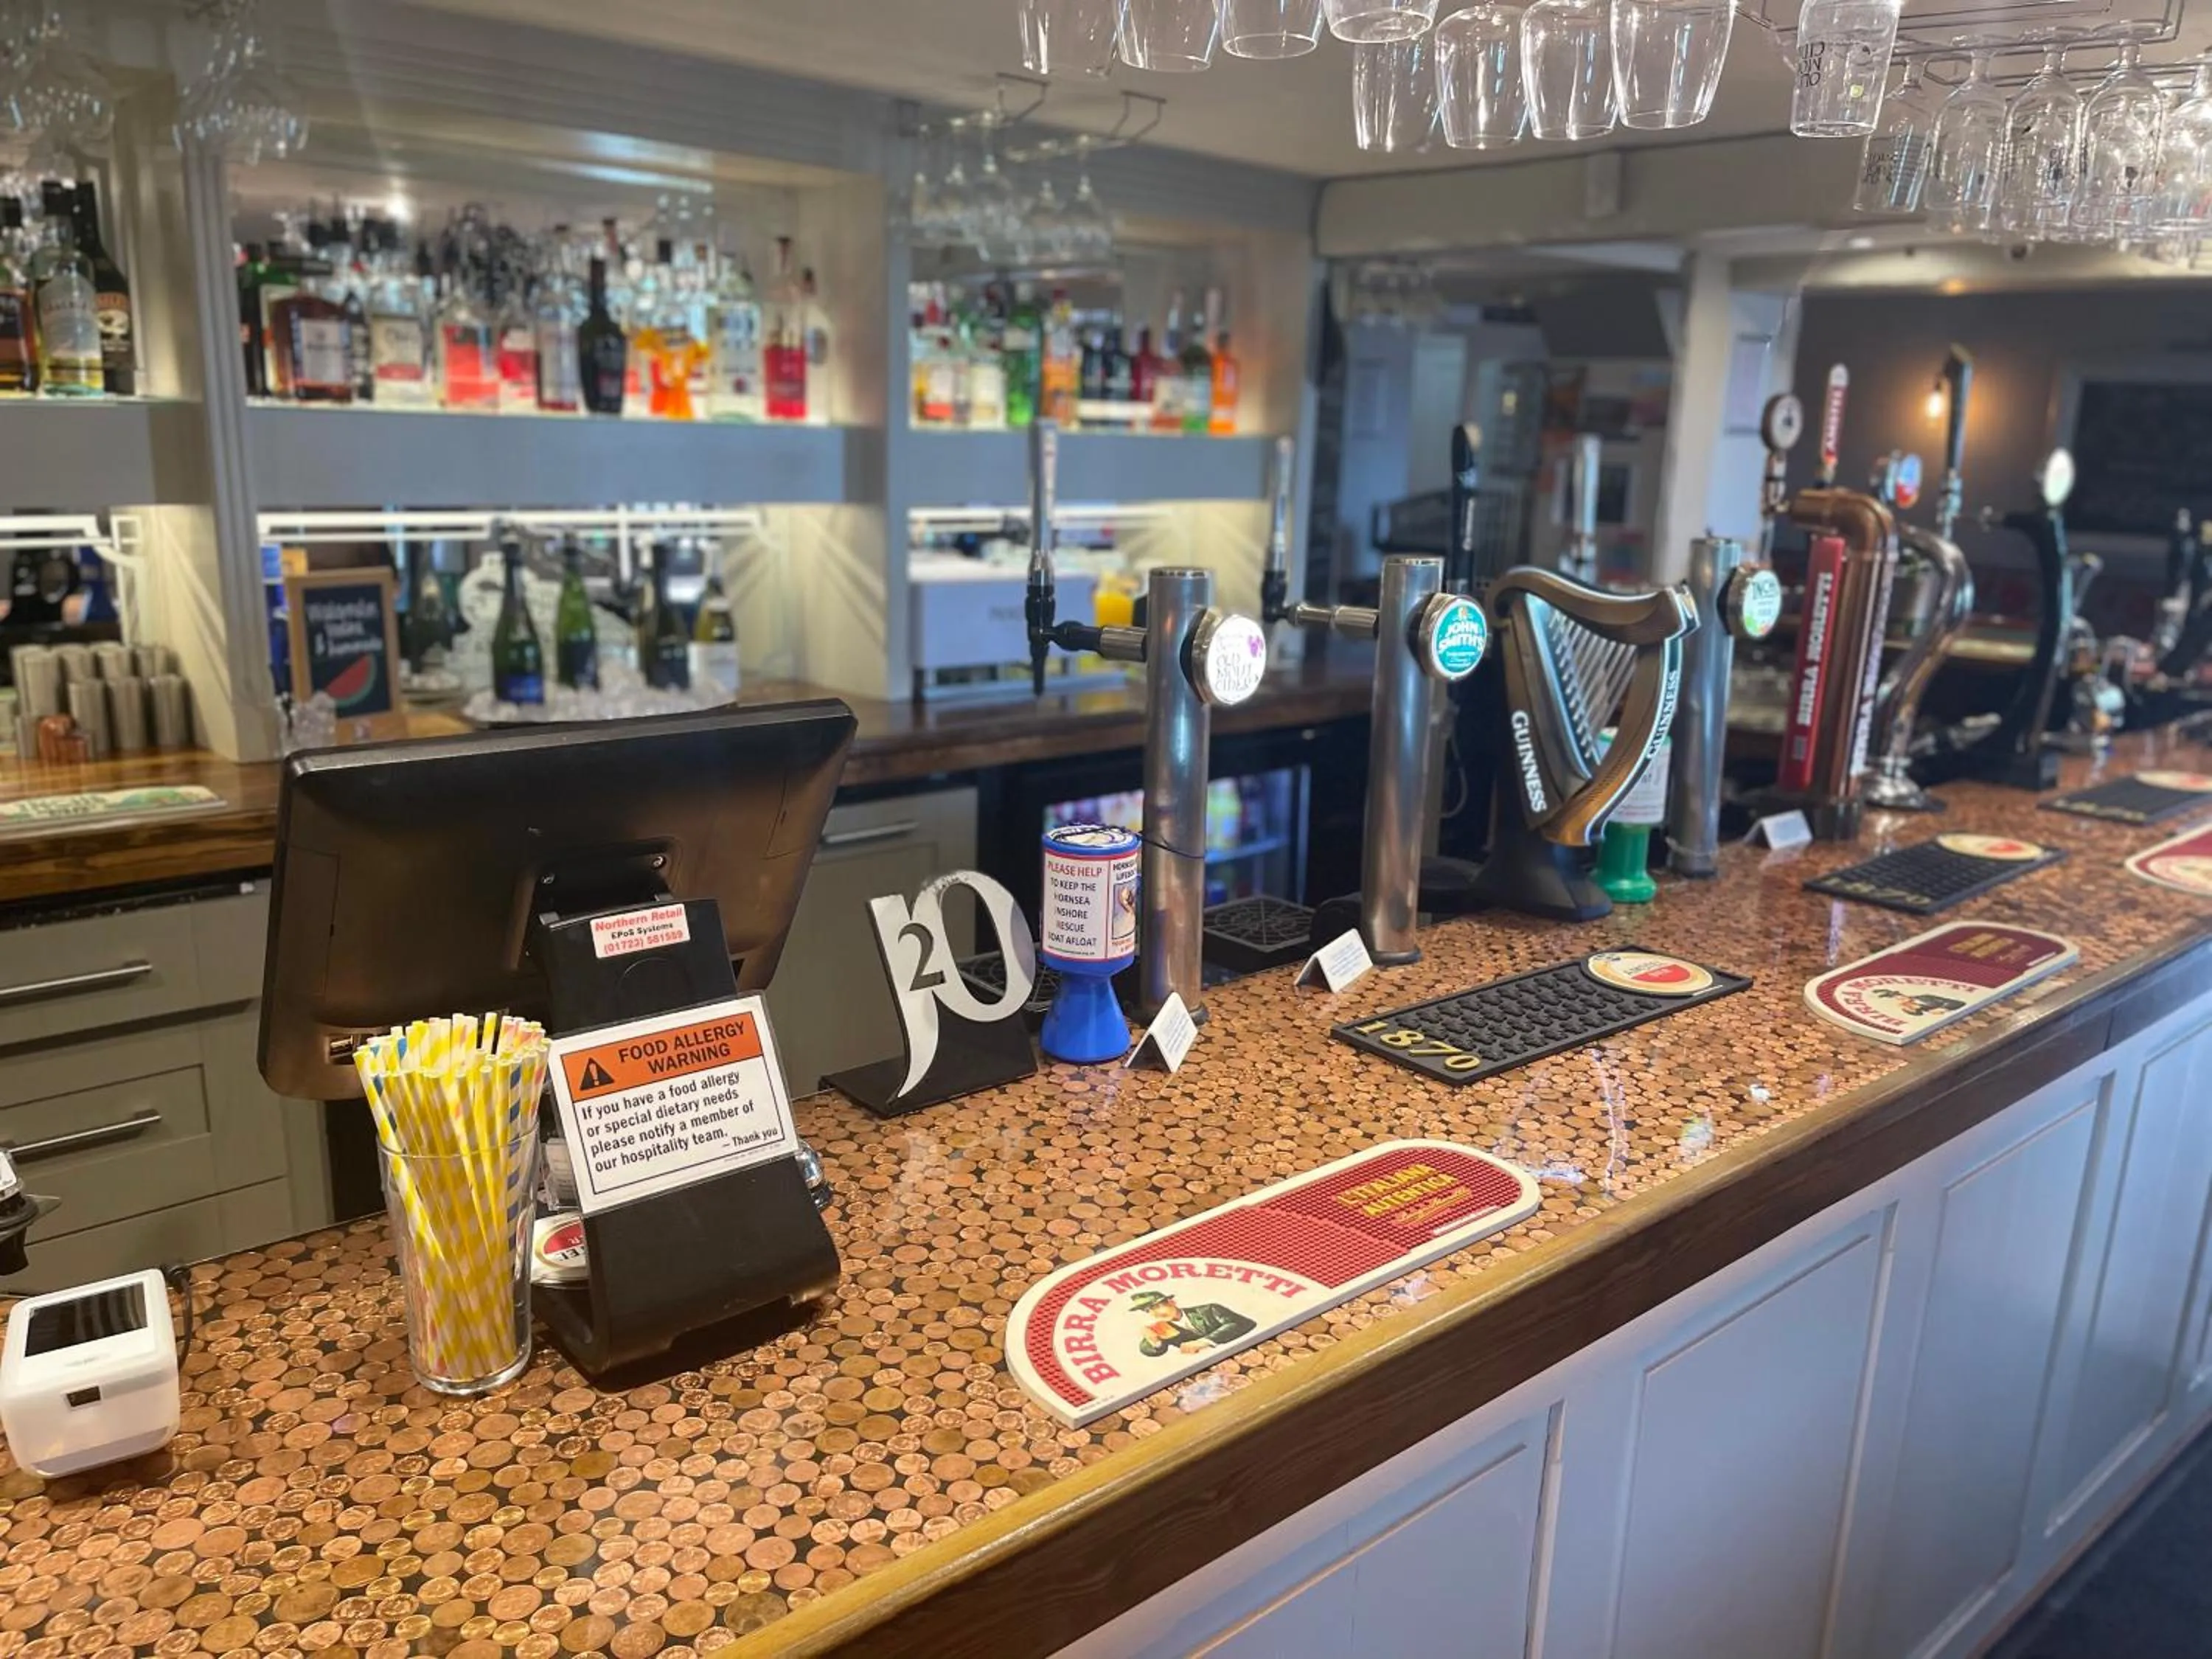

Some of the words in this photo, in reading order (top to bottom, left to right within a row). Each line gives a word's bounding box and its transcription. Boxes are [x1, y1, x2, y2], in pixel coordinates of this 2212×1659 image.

[1512, 710, 1547, 812] GUINNESS
[1048, 860, 1076, 877] PLEASE
[1077, 867, 1102, 877] HELP
[1051, 877, 1059, 887] TO
[1060, 880, 1079, 890] KEEP
[1081, 883, 1096, 891] THE
[595, 915, 647, 931] Northern
[651, 908, 682, 921] Retail
[637, 923, 672, 934] Systems
[1055, 907, 1088, 919] NSHORE
[1066, 936, 1097, 946] AFLOAT
[619, 1040, 667, 1062] FOOD
[674, 1021, 744, 1046] ALLERGY
[647, 1043, 731, 1074] WARNING
[1354, 1020, 1481, 1071] 1870
[582, 1106, 593, 1120] If
[596, 1102, 619, 1119] you
[623, 1094, 654, 1109] have
[658, 1090, 666, 1100] a
[669, 1080, 697, 1098] food
[700, 1072, 740, 1090] allergy
[586, 1124, 599, 1138] or
[604, 1109, 652, 1134] special
[655, 1099, 700, 1119] dietary
[703, 1088, 739, 1105] needs
[590, 1135, 635, 1157] please
[639, 1123, 676, 1141] notify
[679, 1120, 686, 1130] a
[690, 1107, 738, 1127] member
[742, 1099, 754, 1113] of
[731, 1133, 761, 1147] Thank
[762, 1127, 778, 1142] you
[595, 1158, 617, 1172] our
[621, 1138, 689, 1165] hospitality
[692, 1127, 728, 1144] team.
[1363, 1173, 1458, 1216] AUTENTICA
[1063, 1295, 1121, 1386] BIRRA
[1102, 1262, 1309, 1298] MORETTI
